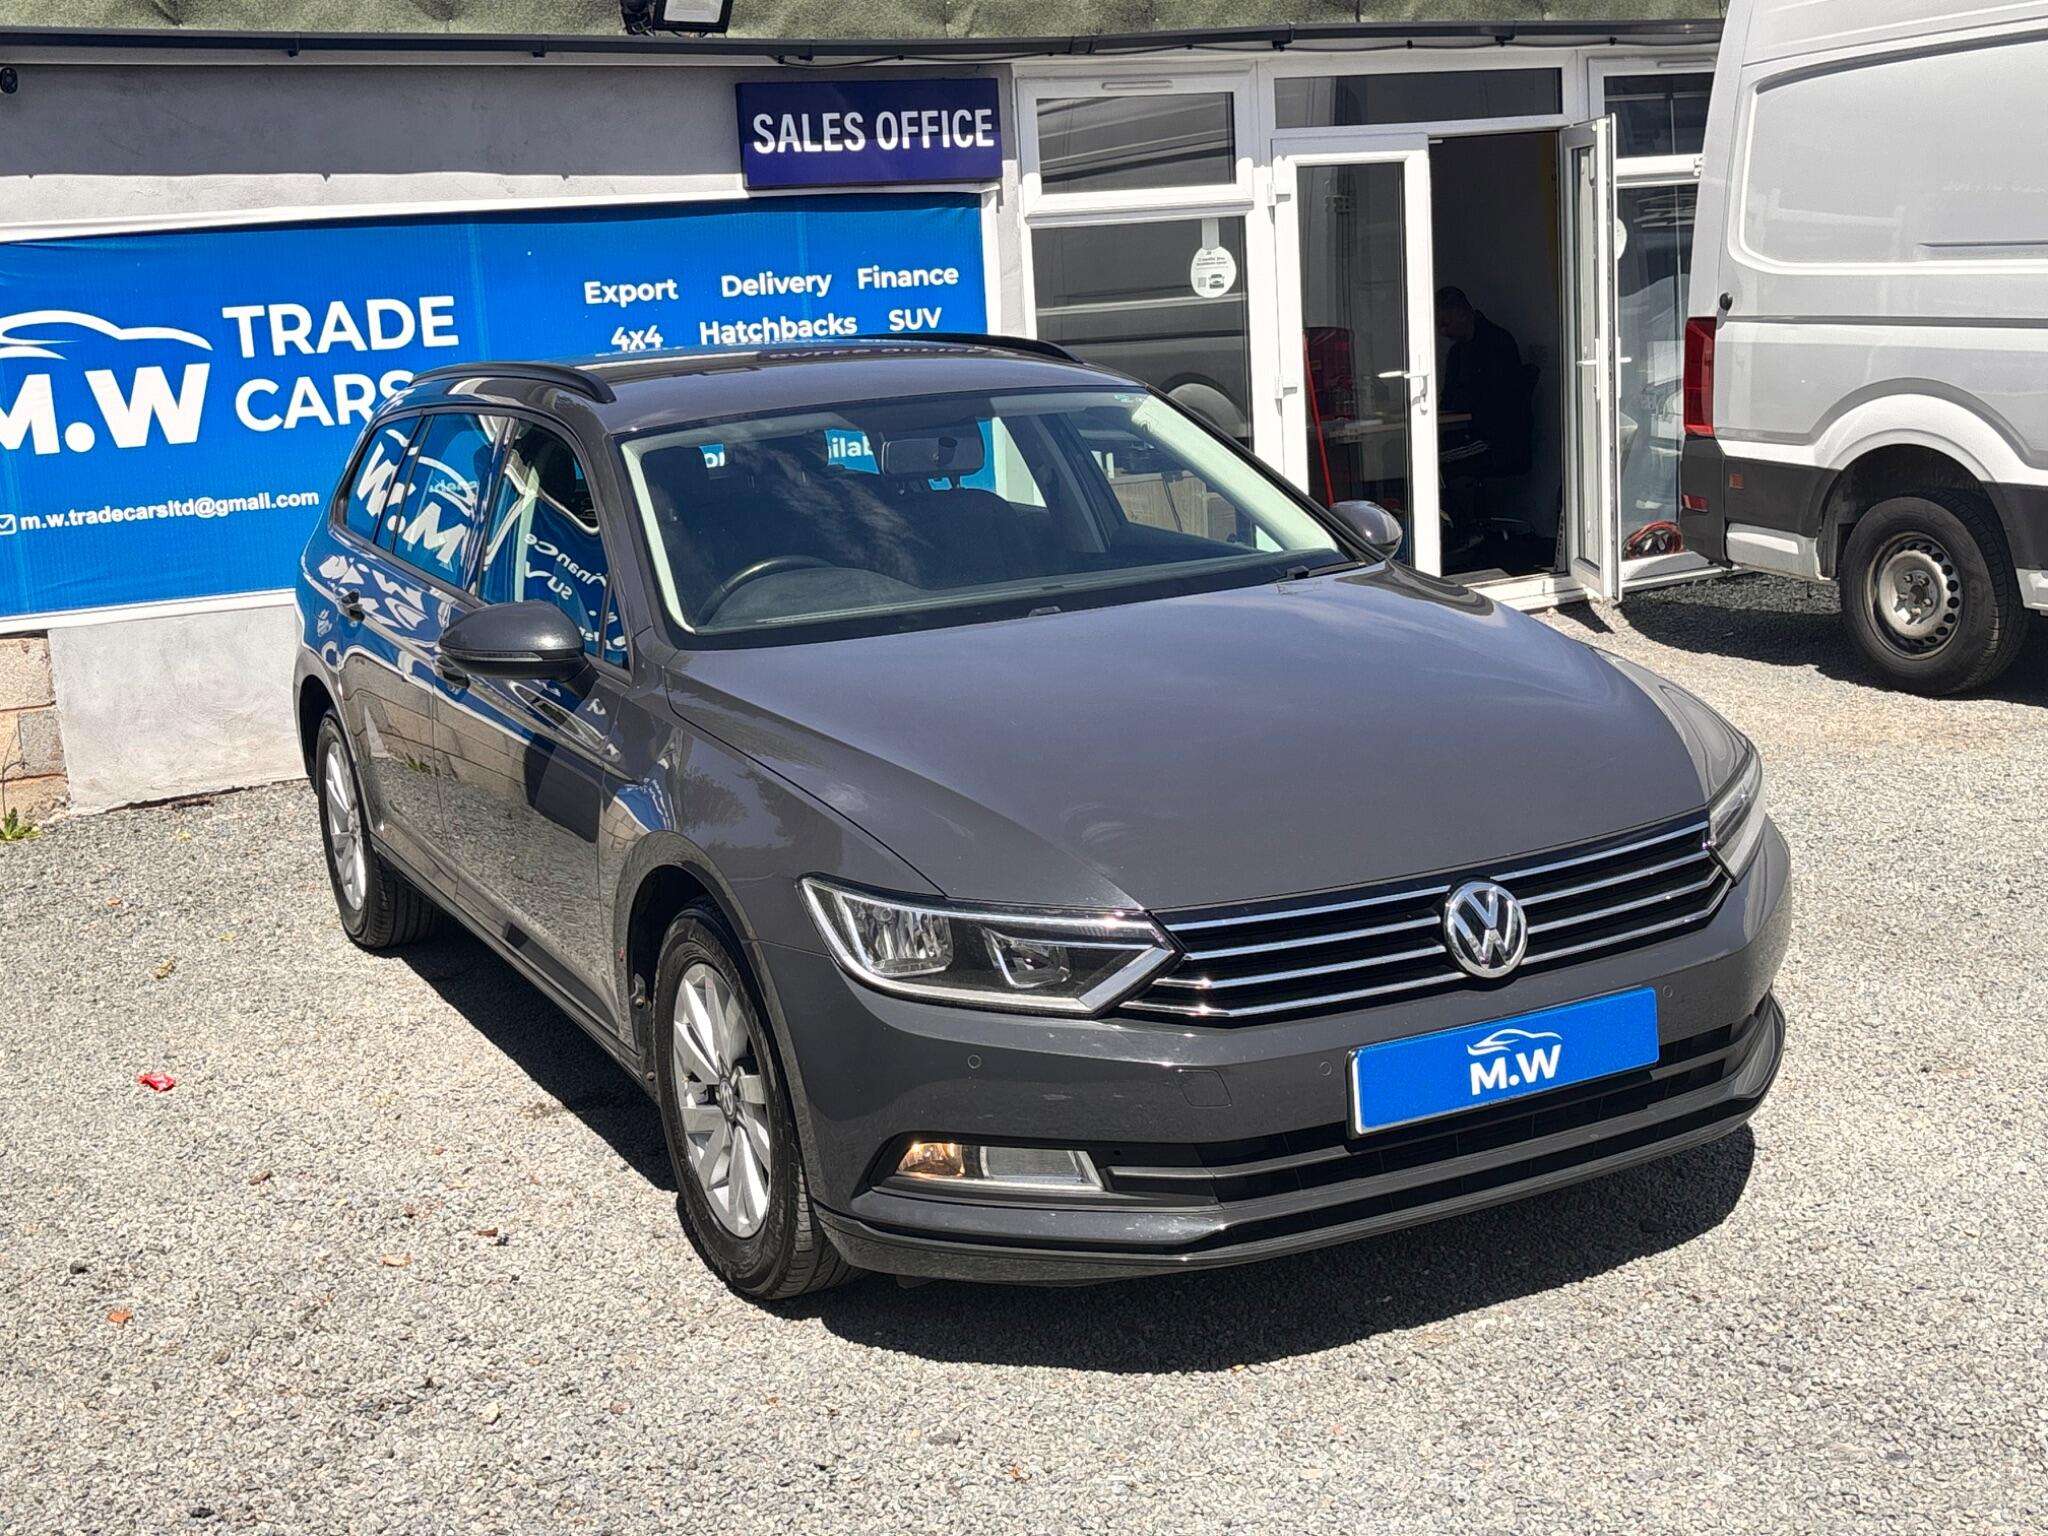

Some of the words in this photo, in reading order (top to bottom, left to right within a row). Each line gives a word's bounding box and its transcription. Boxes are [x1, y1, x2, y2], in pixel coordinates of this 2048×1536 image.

[753, 112, 866, 154] SALES
[876, 108, 995, 151] OFFICE
[721, 271, 832, 298] Delivery
[857, 265, 959, 290] Finance
[584, 279, 679, 308] Export
[222, 295, 459, 358] TRADE
[699, 313, 858, 344] Hatchbacks
[888, 307, 942, 332] SUV
[611, 325, 664, 351] 4x4
[1469, 1044, 1562, 1096] M.W
